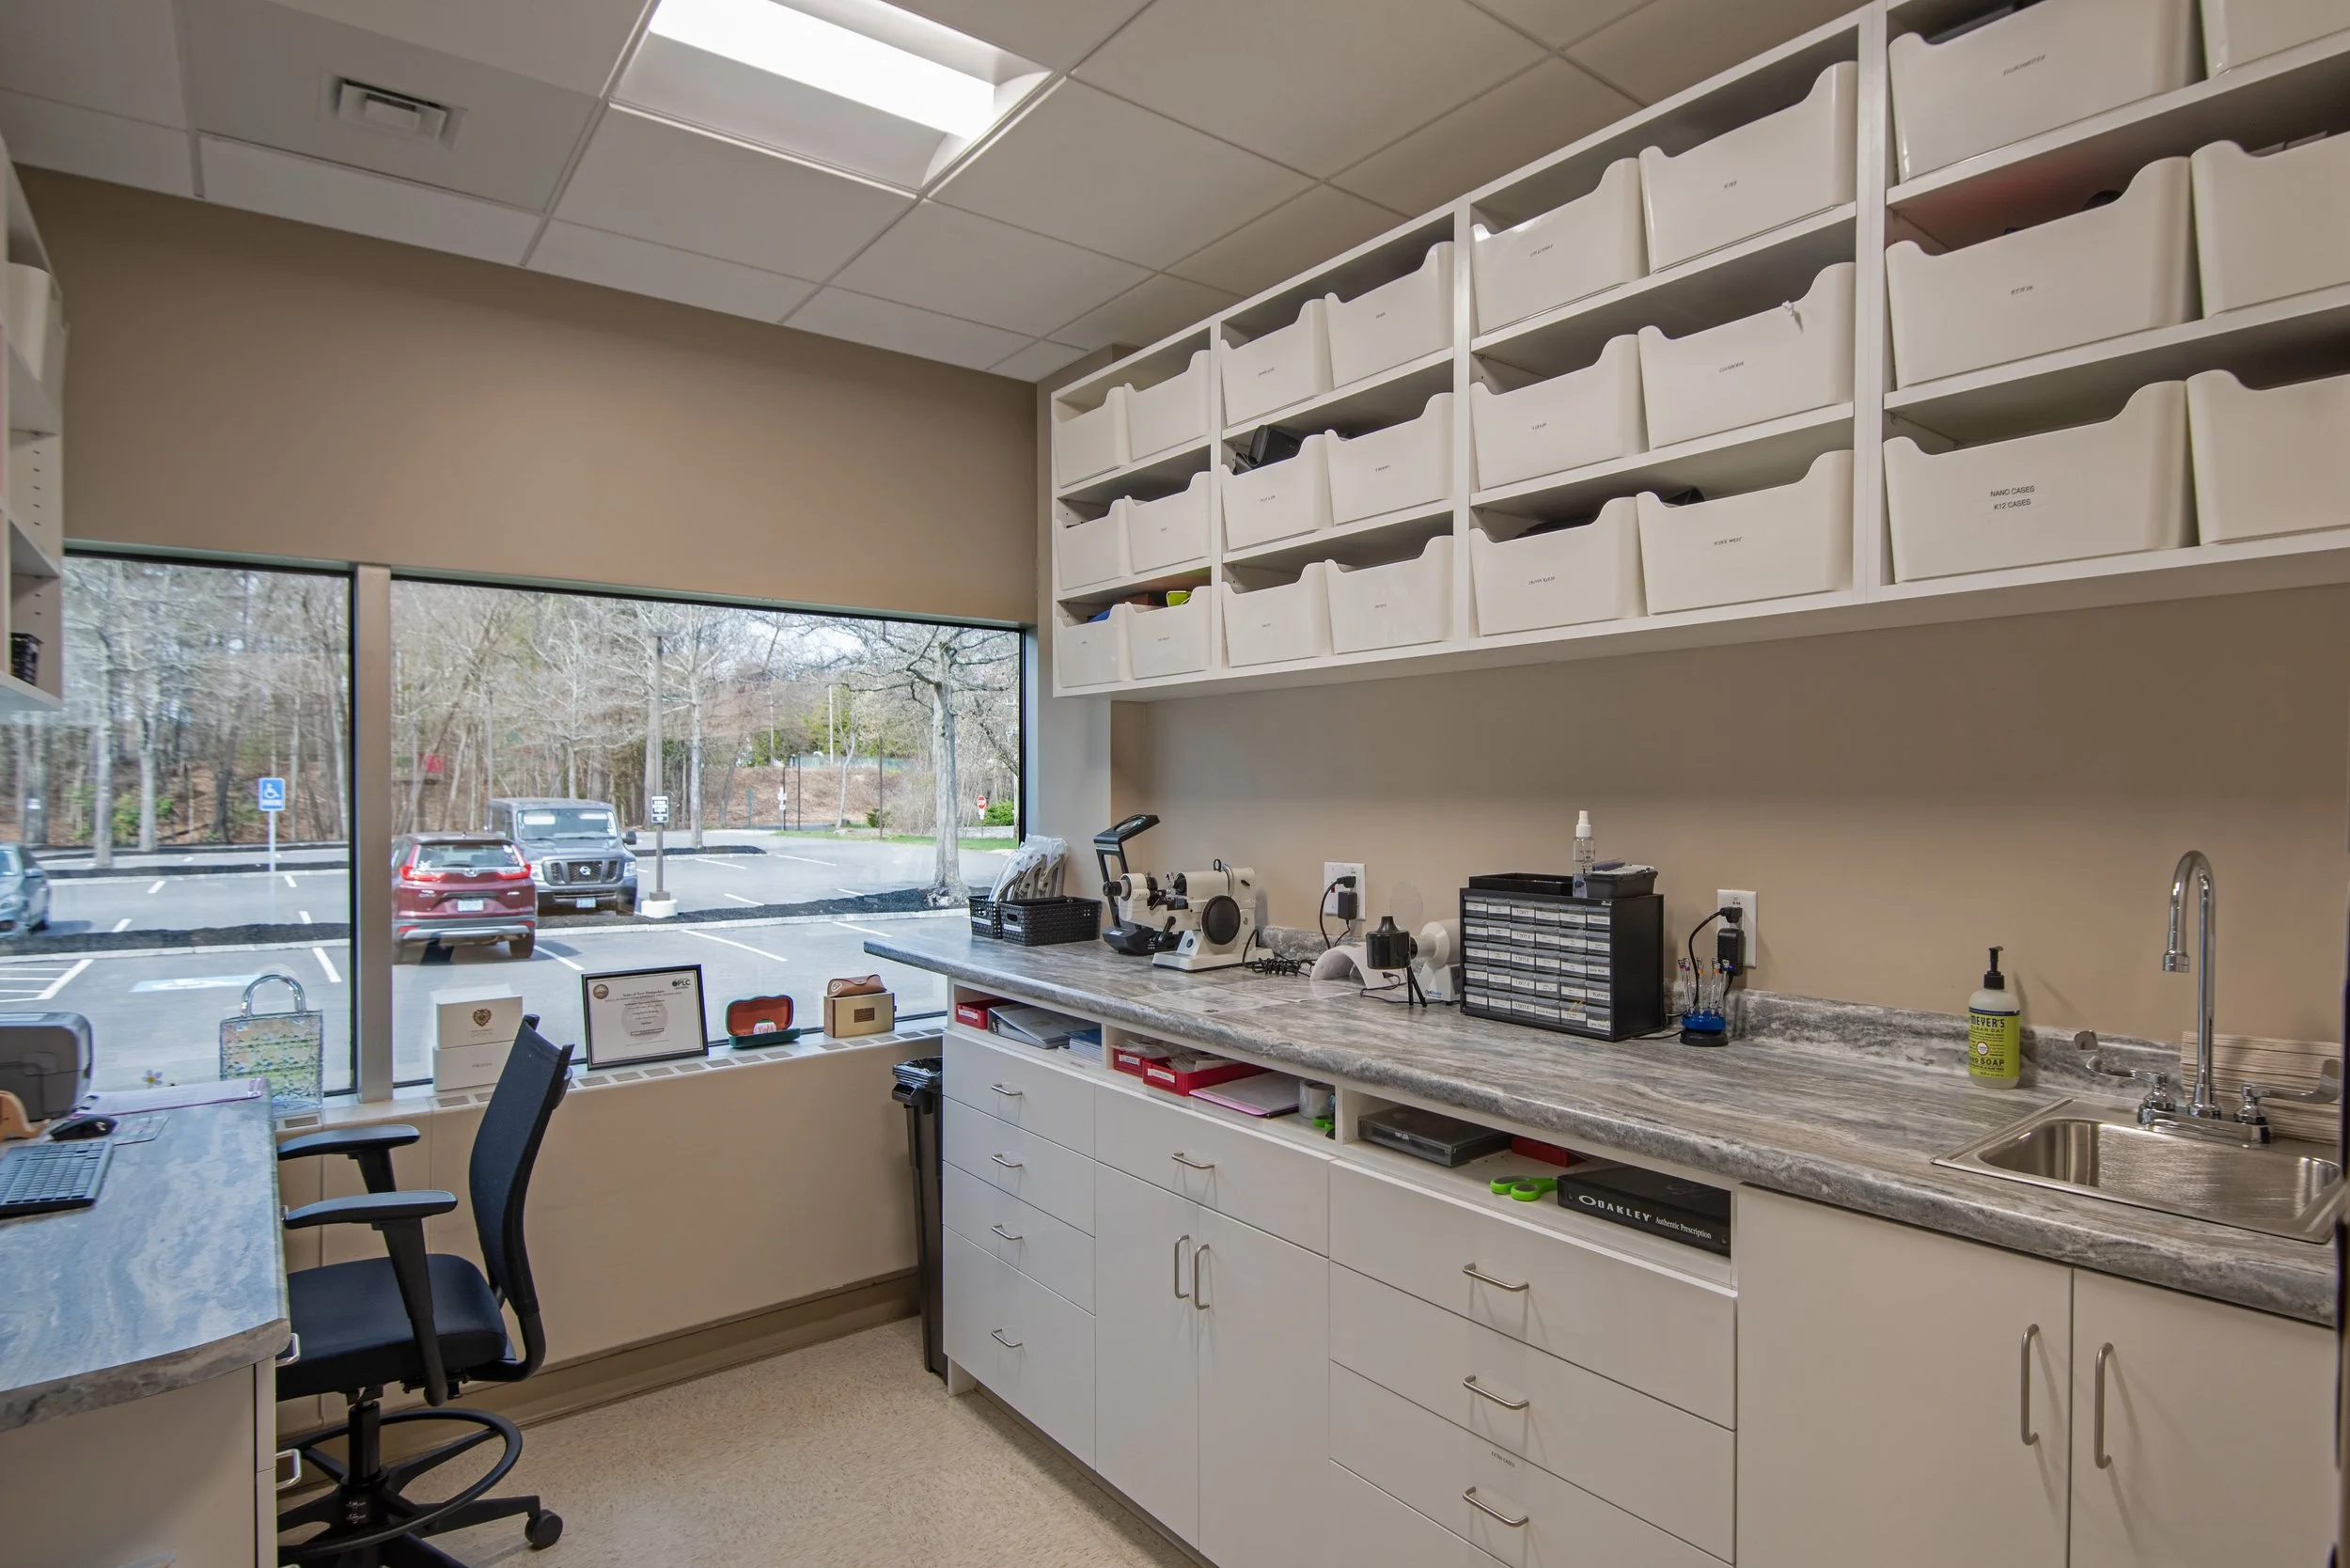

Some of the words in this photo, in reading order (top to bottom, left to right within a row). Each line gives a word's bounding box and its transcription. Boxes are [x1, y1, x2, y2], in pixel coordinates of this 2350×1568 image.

[1990, 488, 2010, 496] NANO
[2011, 485, 2035, 494] CASES
[1994, 502, 2007, 510] K12
[2007, 498, 2031, 509] CASES
[1980, 1058, 2004, 1067] SOAP
[1598, 1200, 1652, 1222] OAKLEY
[1655, 1216, 1680, 1230] Authentic
[1681, 1223, 1712, 1240] Prescription
